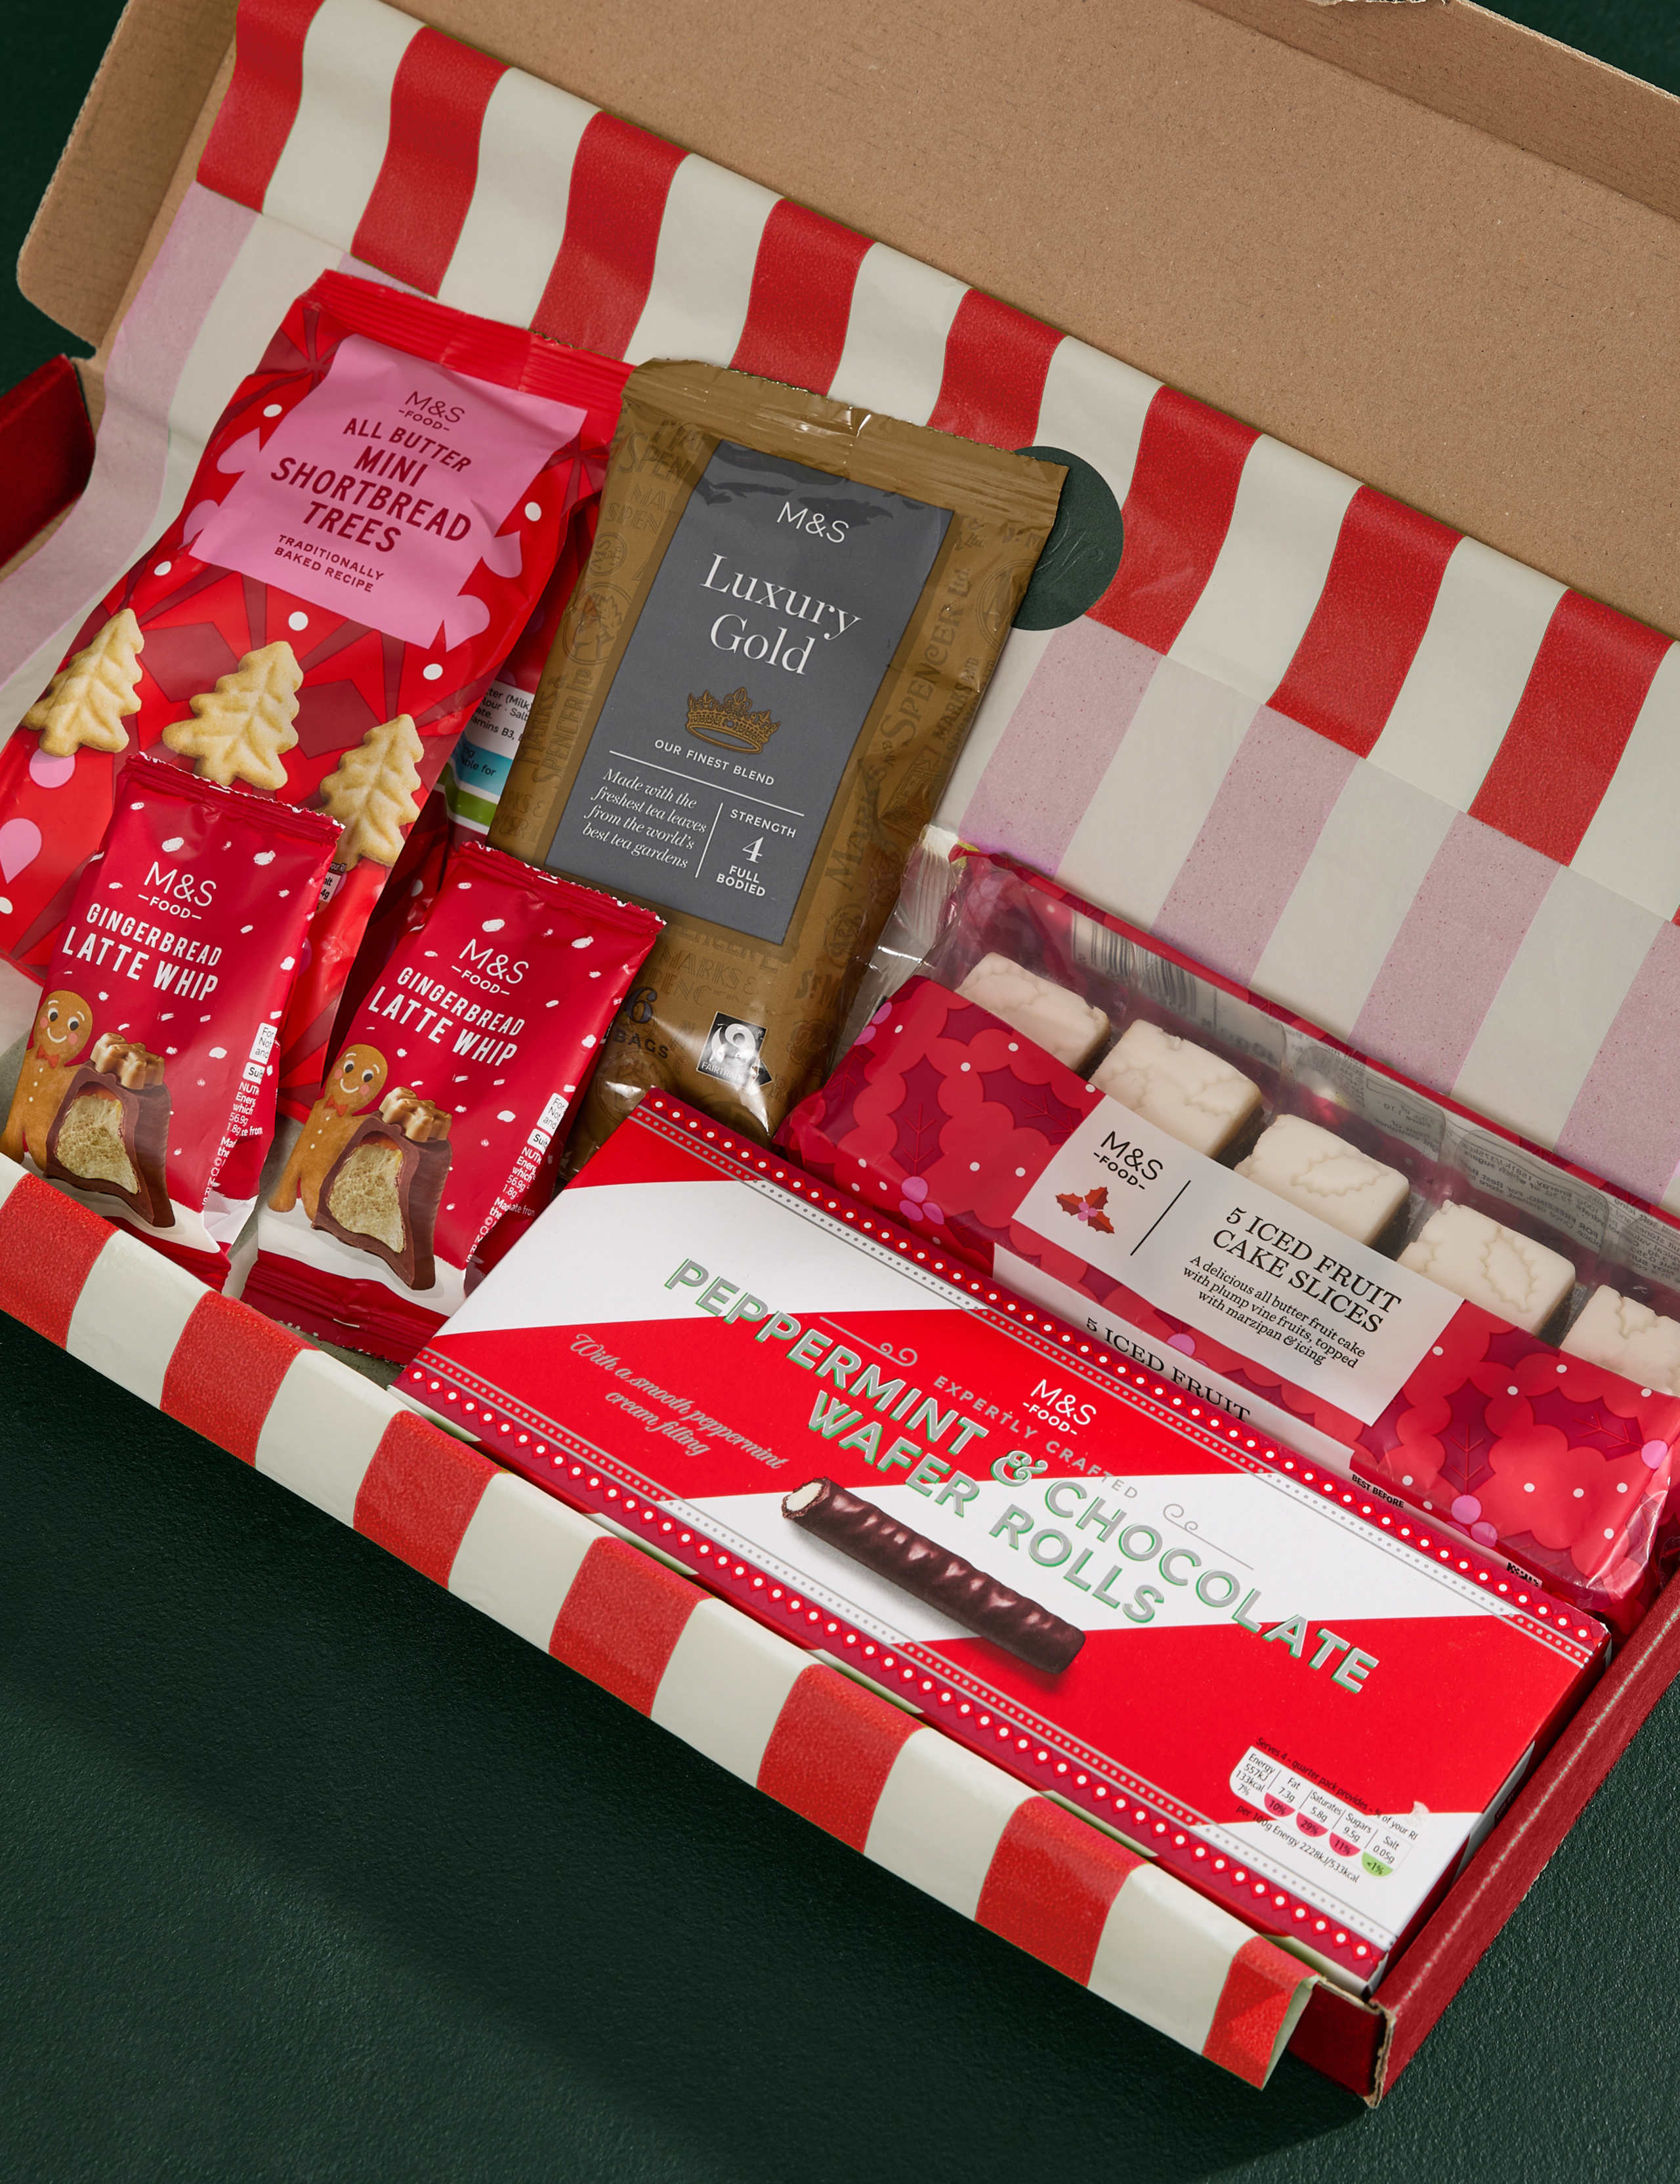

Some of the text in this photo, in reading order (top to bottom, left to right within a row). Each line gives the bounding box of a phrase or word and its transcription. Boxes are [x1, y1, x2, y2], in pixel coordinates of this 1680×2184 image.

[404, 390, 466, 423] M&S
[343, 417, 472, 472] ALL BUTTER
[354, 446, 428, 487] MINI
[270, 457, 471, 541] SHORTBREAD
[303, 501, 401, 552] TREES
[776, 501, 849, 543] M&S
[274, 547, 373, 593] BAKED RECIPE
[278, 534, 384, 581] TRADITIONALLY
[700, 553, 862, 640] Luxury
[710, 614, 815, 675] Gold
[481, 764, 496, 776] for
[603, 768, 697, 808] Made with the
[655, 740, 775, 786] OUR FINEST BLEND
[583, 805, 621, 827] from
[624, 814, 644, 833] the
[591, 786, 707, 833] freshest tea leaves
[730, 809, 797, 838] STRENGTH
[583, 822, 688, 870] best tea gardens
[742, 836, 765, 864] 4
[144, 861, 217, 907] M&S
[716, 873, 766, 897] BODIED
[729, 865, 760, 884] FULL
[86, 903, 222, 967] GINGERBREAD
[459, 938, 529, 984] M&S
[62, 927, 219, 1001] LATTE WHIP
[368, 986, 518, 1066] LATTE WHIP
[397, 967, 525, 1036] GINGERBREAD
[613, 1028, 669, 1059] BAGS
[1100, 1131, 1164, 1181] M&S
[1213, 1230, 1383, 1333] CAKE SLICES
[1226, 1208, 1402, 1314] 5 ICED FRUIT
[1183, 1267, 1359, 1368] with plump vine fruits, topped
[1190, 1255, 1366, 1358] A delicious all butter fruit cake
[1198, 1290, 1326, 1366] with marzipan & icing
[1086, 1317, 1250, 1423] 5 ICED FRUIT
[570, 1334, 789, 1470] With a smooth peppermint
[605, 1391, 711, 1457] cream filling
[1030, 1379, 1097, 1426] M&S
[933, 1375, 1139, 1500] EXPERTLY CRAFTED
[664, 1258, 1379, 1693] PEPPERMINT & CHOCOLATE
[1352, 1474, 1404, 1508] BEST BEFORE
[808, 1390, 1164, 1624] WAFER ROLLS
[1238, 1783, 1250, 1796] 7%
[1244, 1763, 1395, 1864] 557kJ 7.3g 5.8g 9.5g 0.05g
[1248, 1753, 1400, 1850] Energy Fat Saturates Sugars Salt
[1256, 1737, 1418, 1841] Serves 4 quarter pack provides % of your RI
[1235, 1770, 1383, 1875] 133kcal 10% 29% 11% <1%
[1236, 1805, 1360, 1884] per 100g Energy 2228kJ/533kcal
